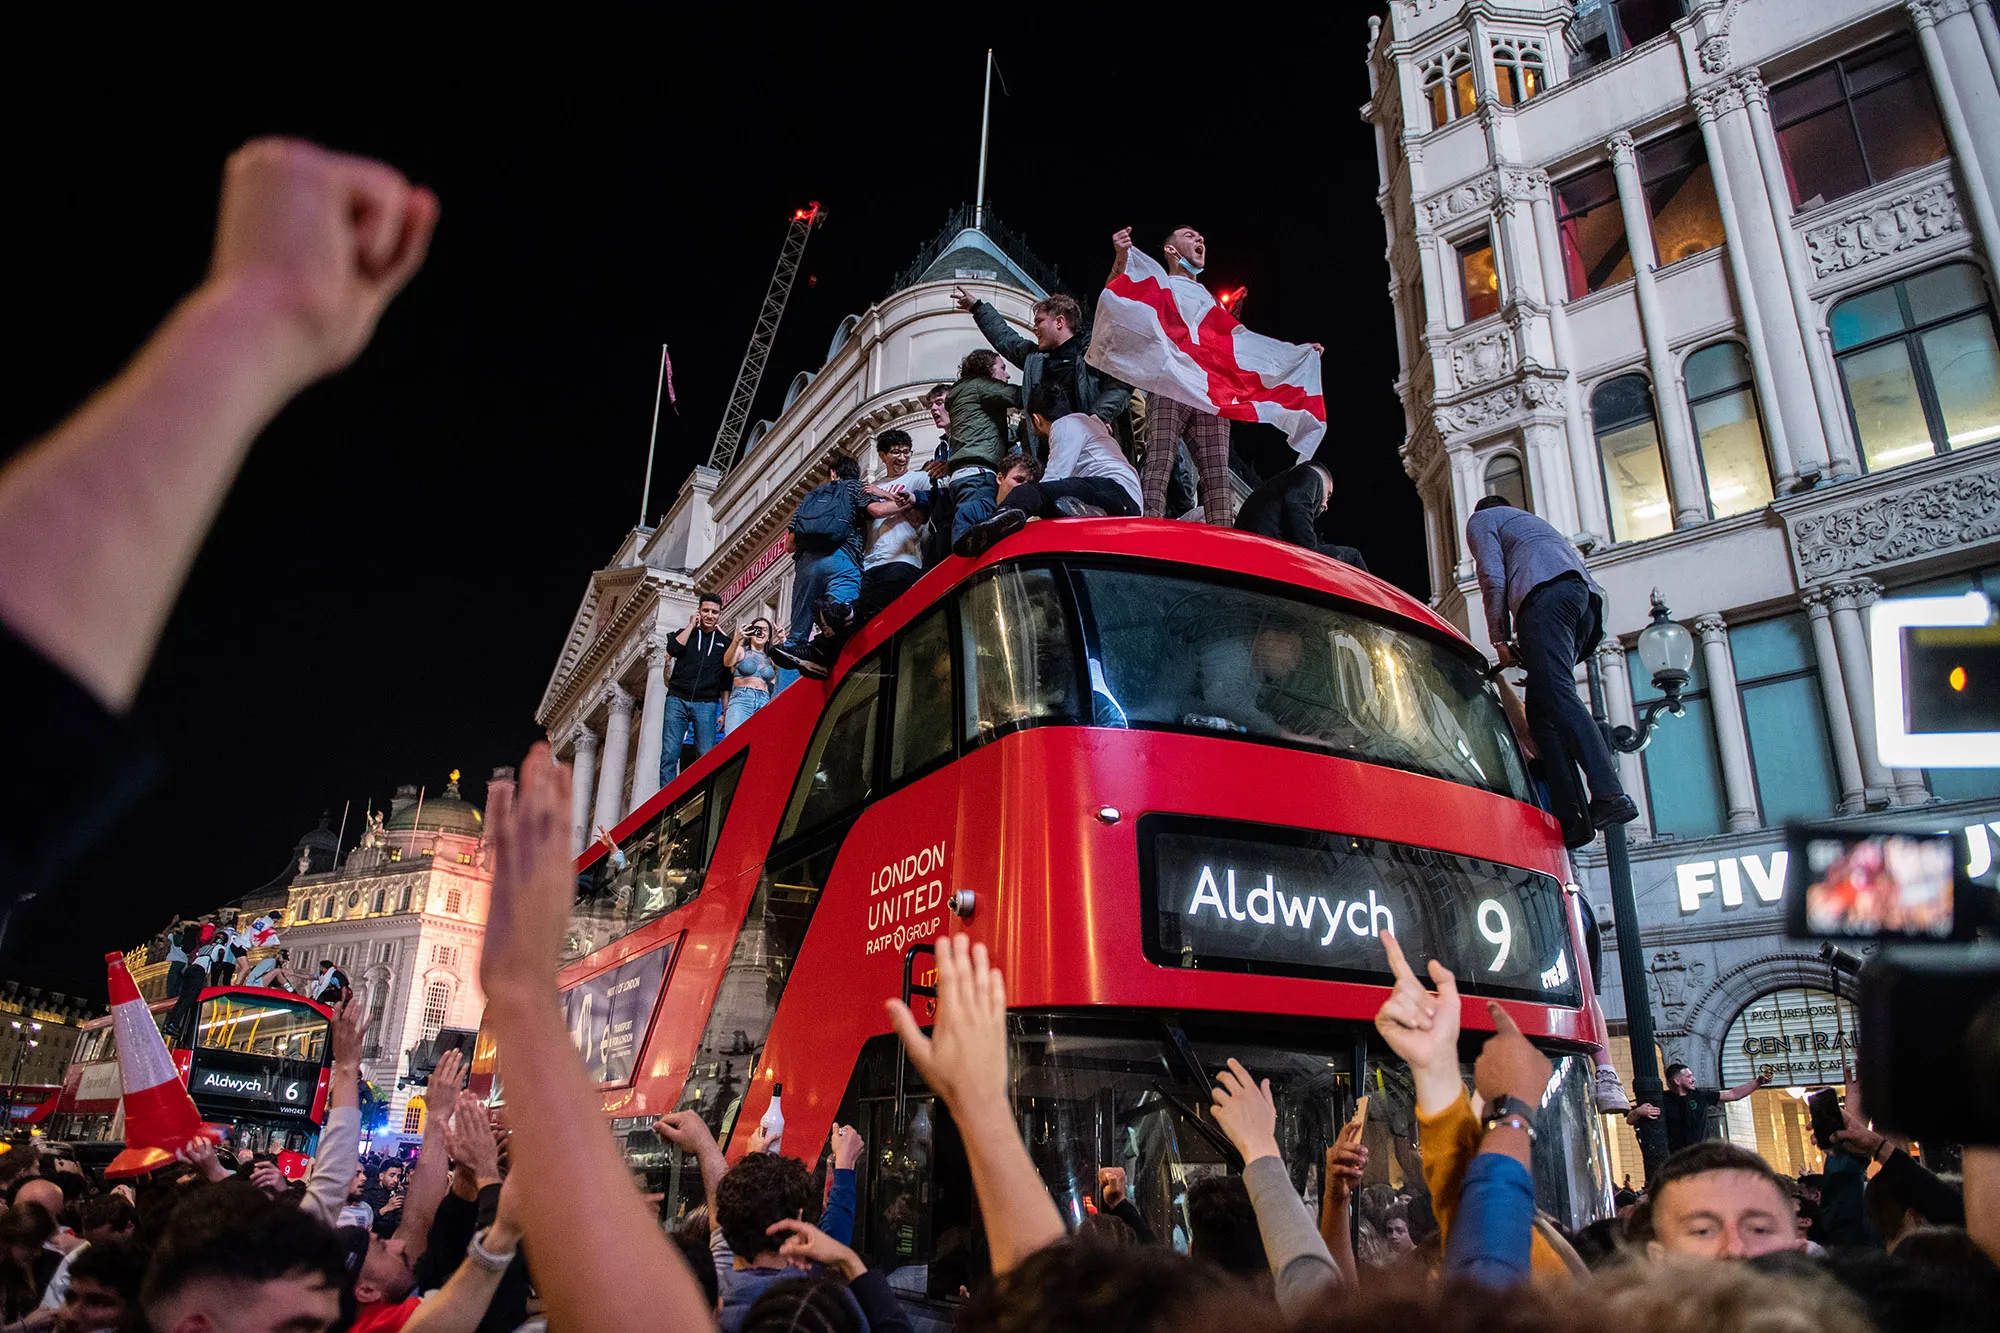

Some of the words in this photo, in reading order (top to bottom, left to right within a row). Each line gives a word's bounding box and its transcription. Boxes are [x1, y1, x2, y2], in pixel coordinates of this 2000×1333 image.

[870, 840, 946, 896] LONDON
[1676, 850, 1790, 912] FIV
[868, 880, 943, 931] UNITED
[1188, 866, 1395, 946] Aldwych
[1477, 898, 1512, 971] 9
[866, 934, 892, 955] RATP
[907, 917, 941, 942] GROUP
[204, 1073, 262, 1092] Aldwych
[285, 1082, 299, 1100] 6
[1759, 1063, 1805, 1074] CNEMA
[1808, 1061, 1817, 1071] &
[284, 1165, 291, 1175] 9
